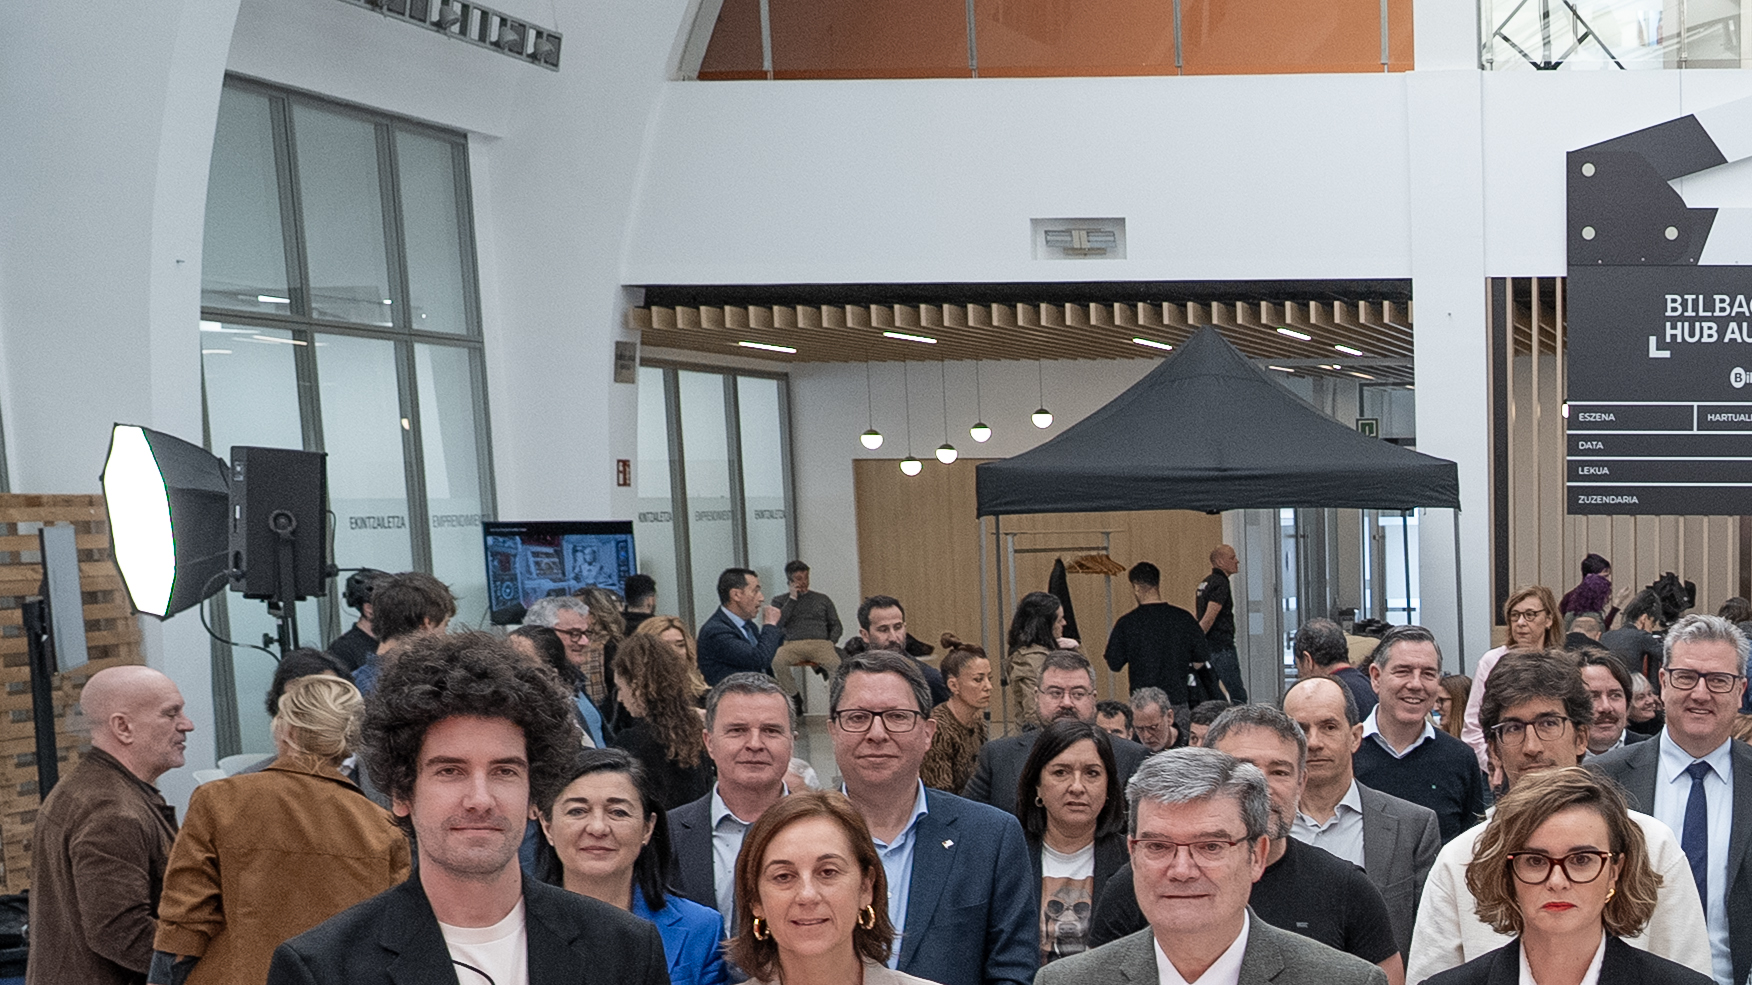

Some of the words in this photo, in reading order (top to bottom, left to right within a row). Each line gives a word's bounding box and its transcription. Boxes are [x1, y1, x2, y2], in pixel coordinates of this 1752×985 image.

[1664, 322, 1718, 343] HUB
[1578, 412, 1616, 422] ESZENA
[1578, 441, 1604, 450] DATA
[1578, 466, 1610, 475] LEKUA
[1577, 495, 1639, 504] ZUZENDARIA
